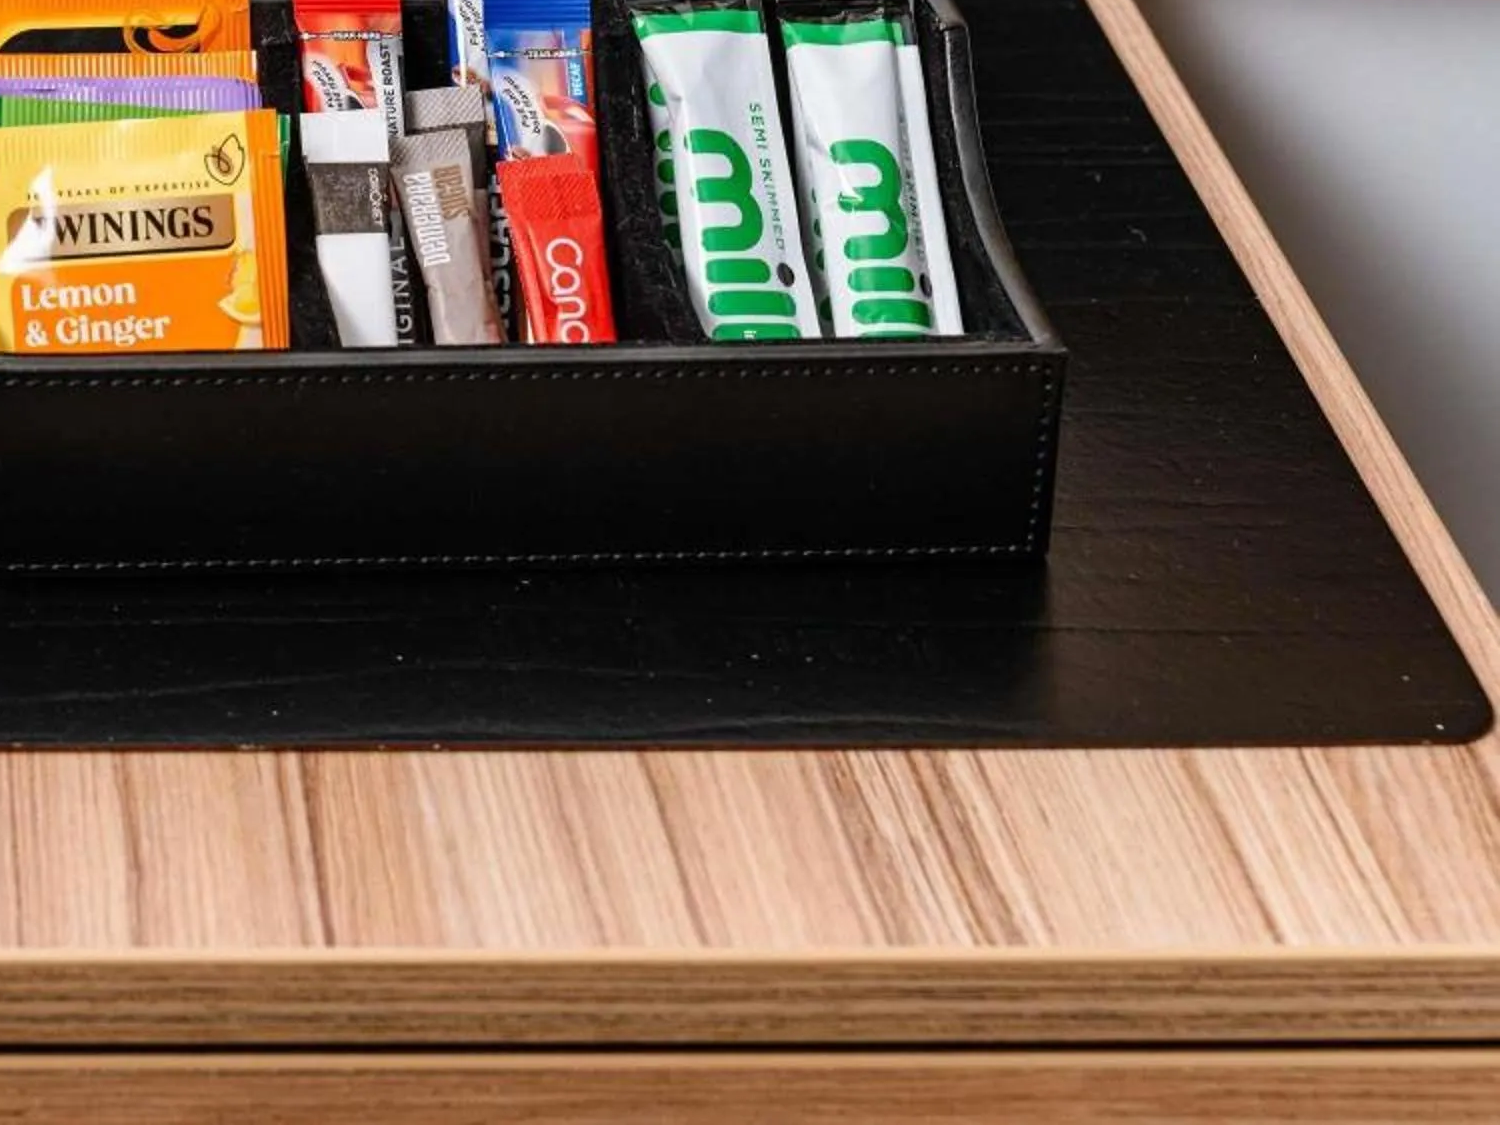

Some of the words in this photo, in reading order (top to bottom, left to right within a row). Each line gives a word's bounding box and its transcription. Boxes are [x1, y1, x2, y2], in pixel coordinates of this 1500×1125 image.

[379, 42, 394, 87] ROAST
[570, 62, 584, 97] DECAF
[749, 102, 768, 150] SEMI
[759, 157, 786, 251] SKIMMED
[21, 282, 138, 312] Lemon
[25, 319, 50, 348] &
[55, 314, 172, 347] Ginger
